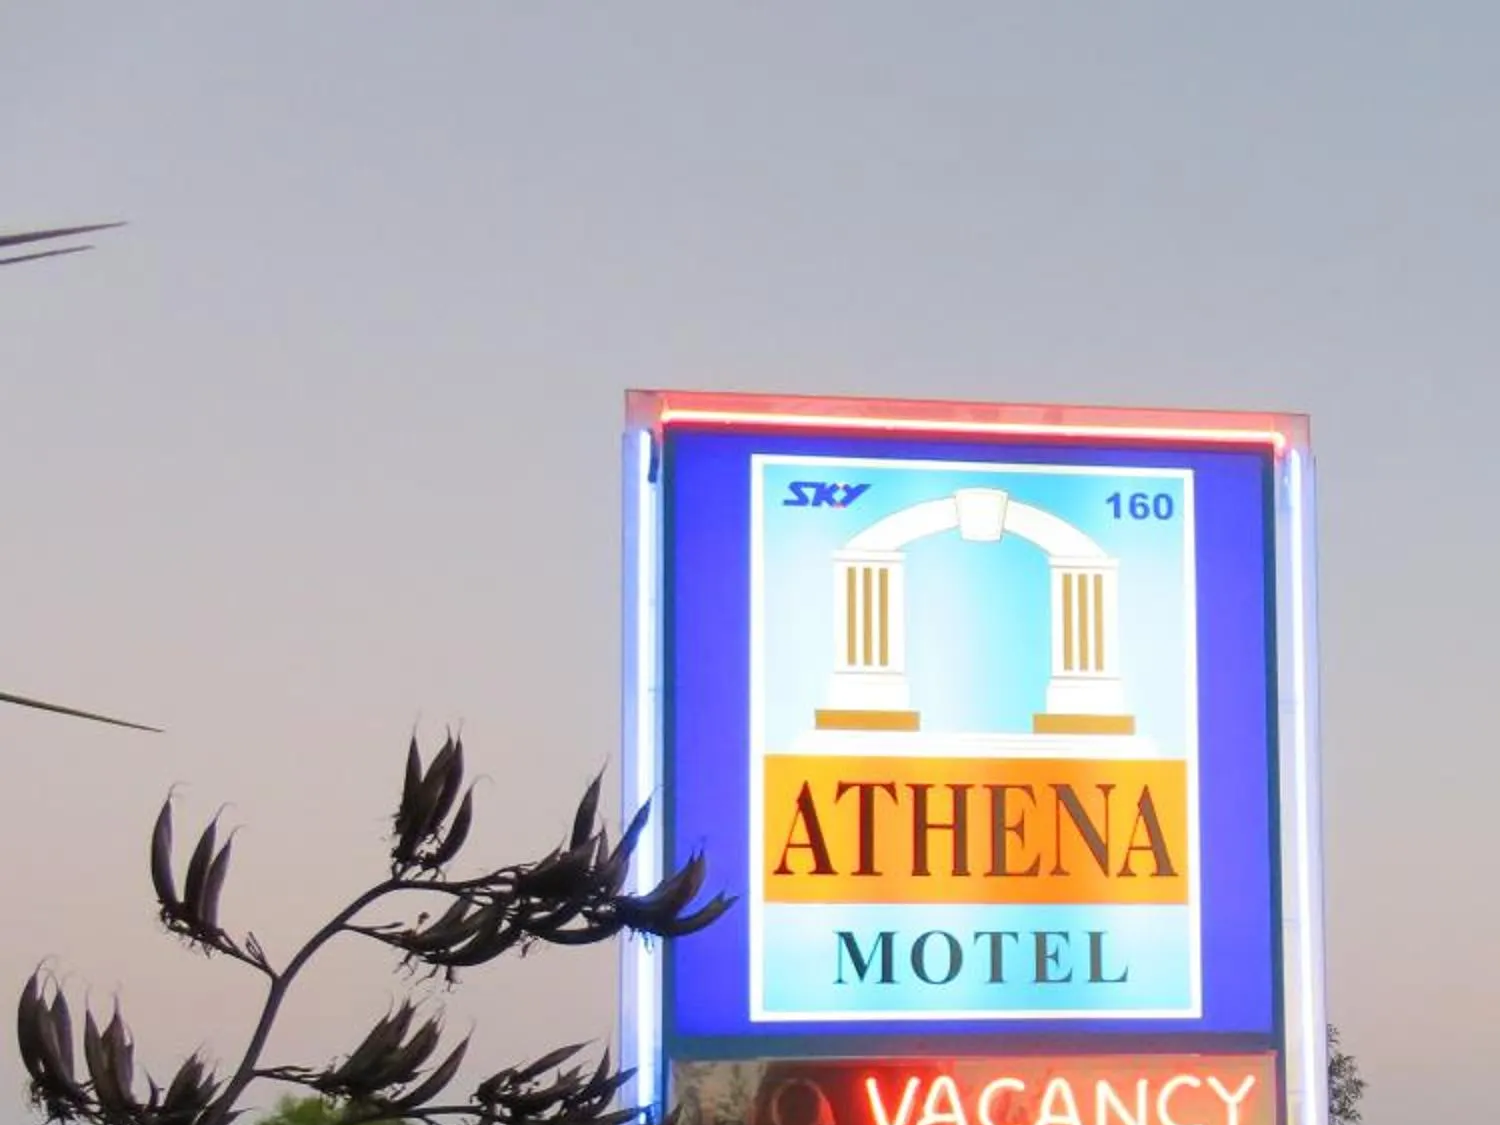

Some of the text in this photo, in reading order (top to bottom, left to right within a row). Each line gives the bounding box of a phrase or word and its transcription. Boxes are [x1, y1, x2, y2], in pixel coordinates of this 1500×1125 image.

[782, 481, 871, 509] SKY
[1104, 492, 1175, 521] 160
[773, 780, 1178, 878] ATHENA
[834, 930, 1129, 985] MOTEL
